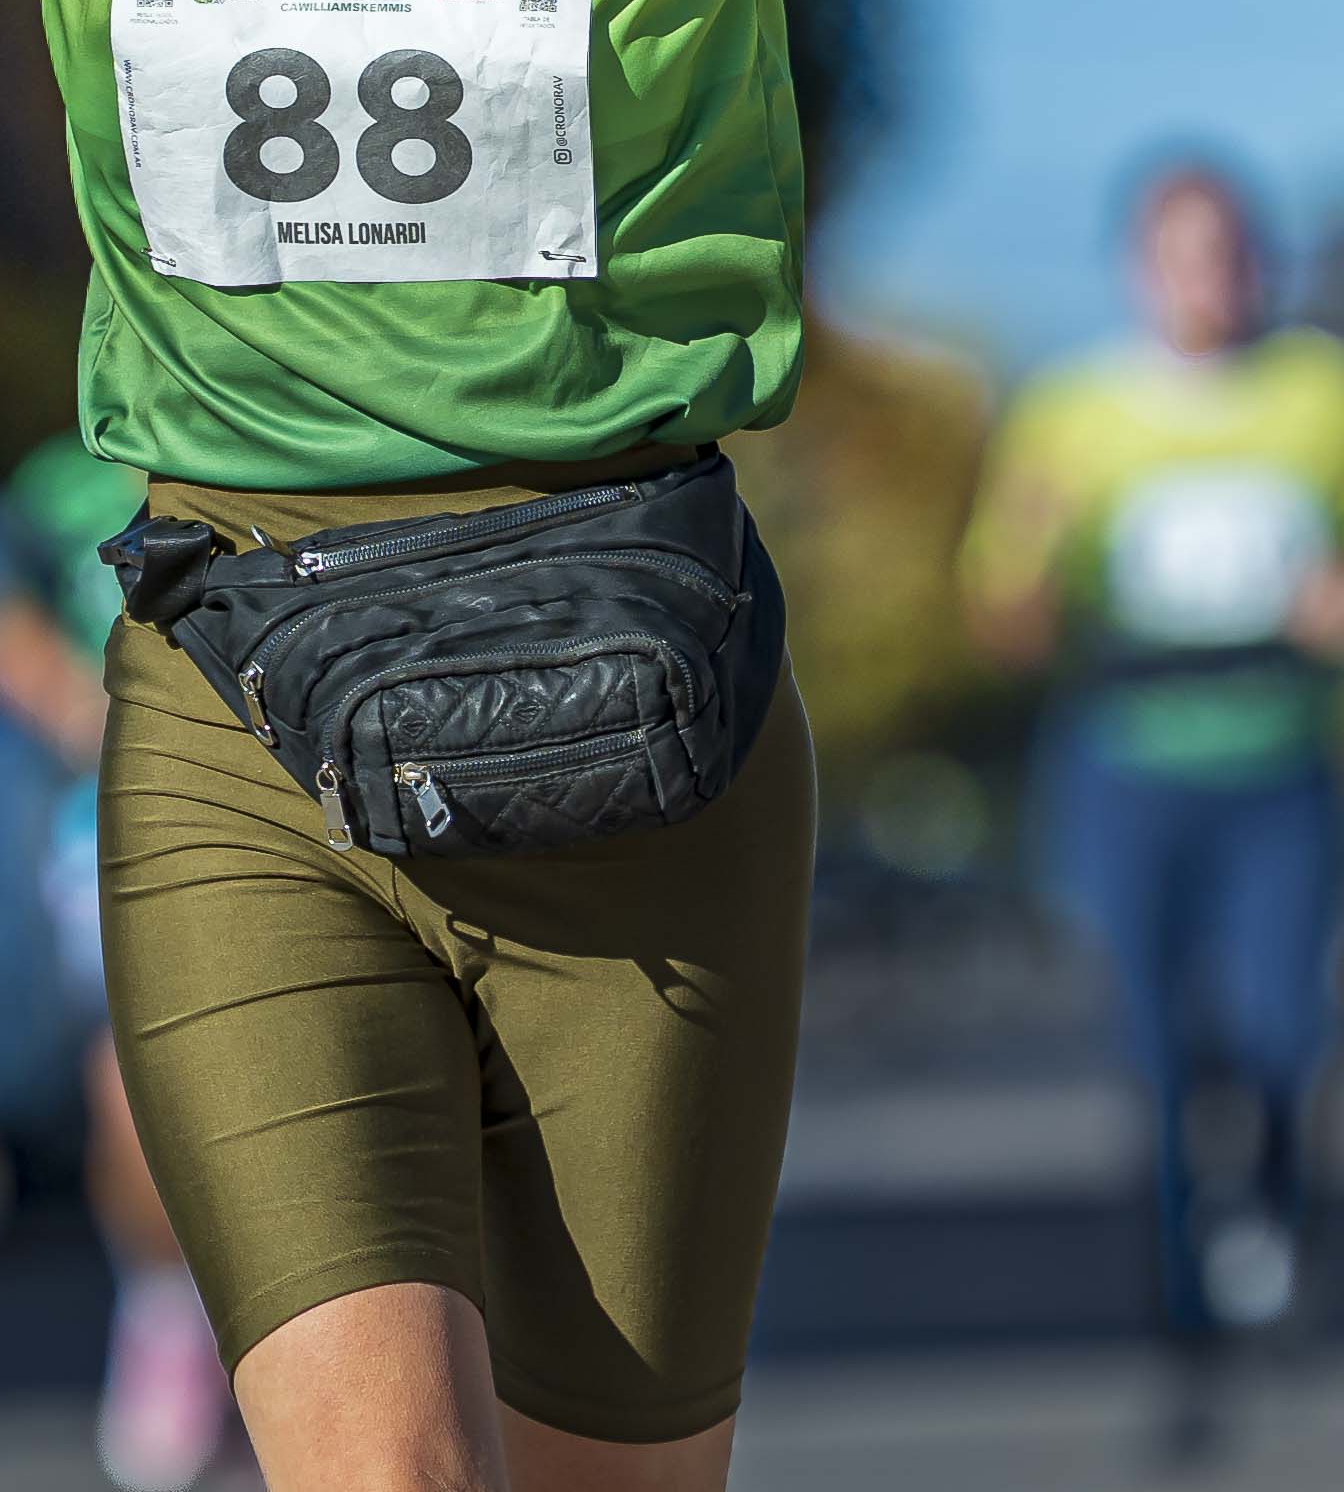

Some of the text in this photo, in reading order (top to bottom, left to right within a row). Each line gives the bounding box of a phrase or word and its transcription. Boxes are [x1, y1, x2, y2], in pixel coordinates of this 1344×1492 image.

[223, 47, 473, 205] 88
[552, 75, 568, 147] @CRONORAV
[277, 221, 427, 245] MELISA LONARDI
